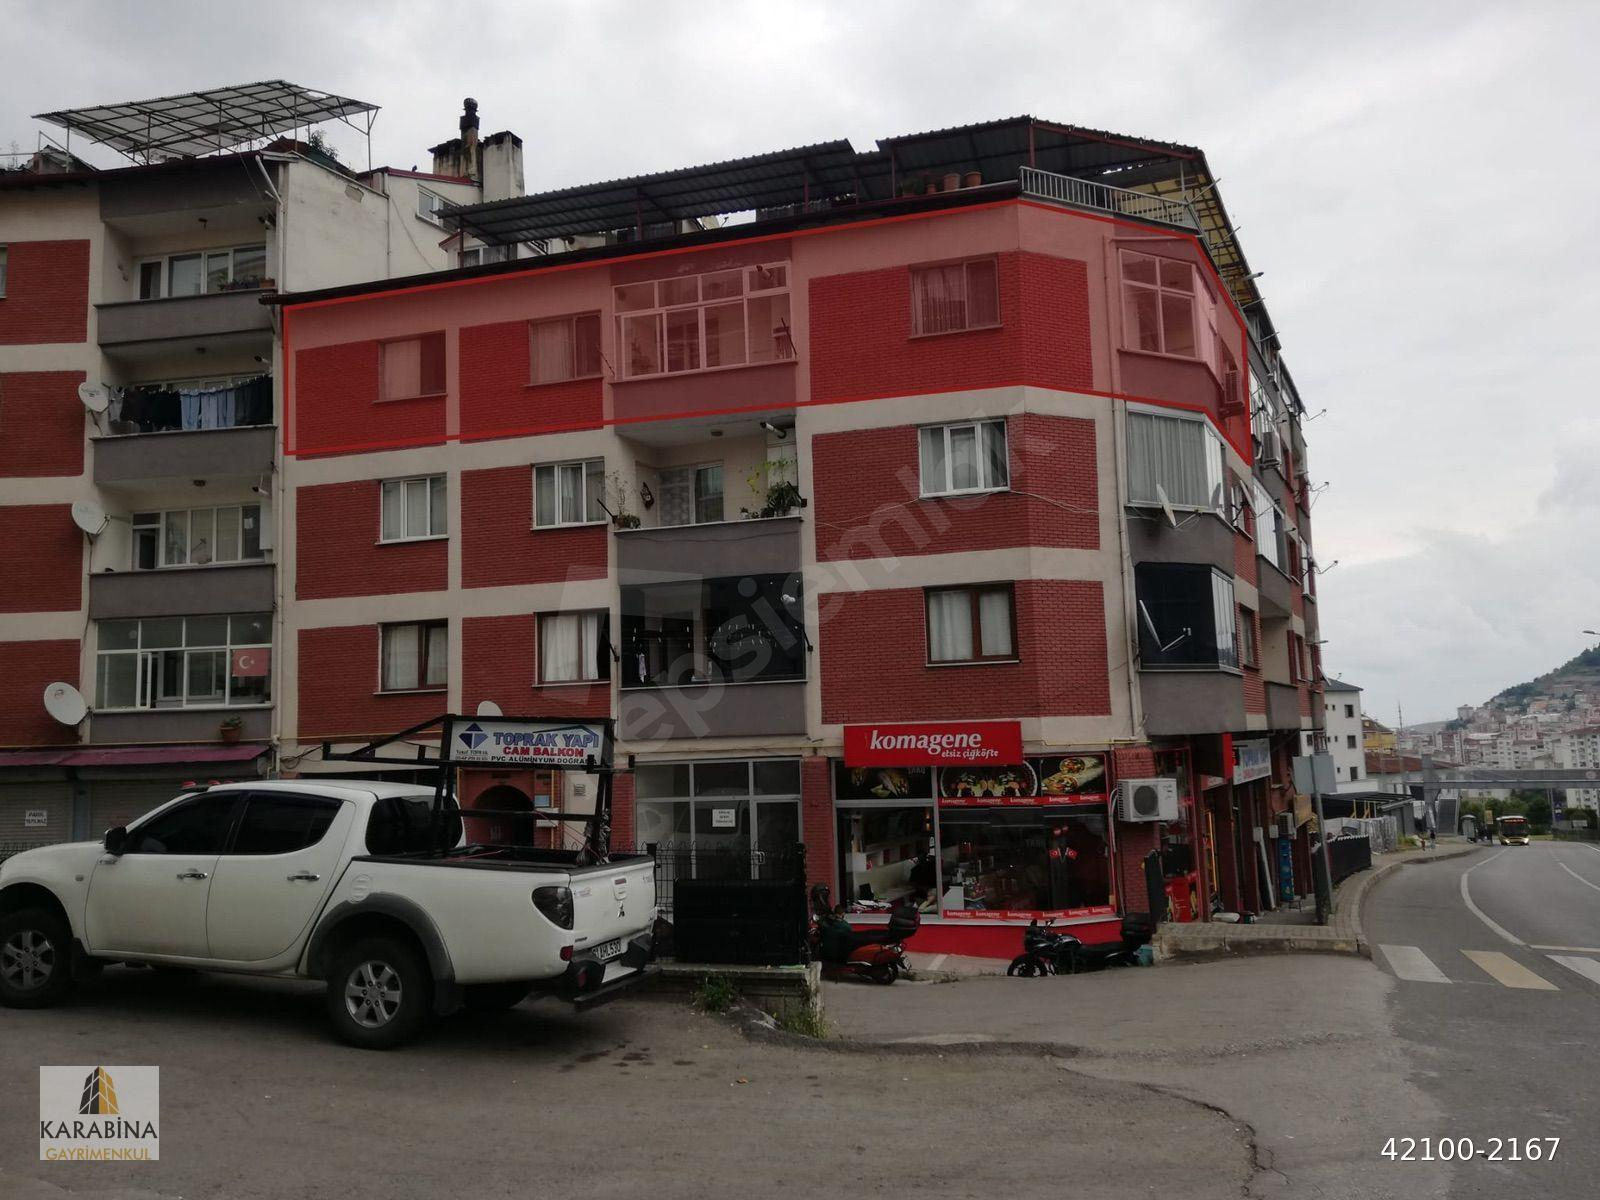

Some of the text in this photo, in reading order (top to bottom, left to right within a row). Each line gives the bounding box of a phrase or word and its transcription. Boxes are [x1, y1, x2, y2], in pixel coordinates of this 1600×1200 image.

[493, 732, 599, 748] TOPRAK YAPI
[869, 730, 982, 755] komagene
[503, 746, 584, 757] CAM BALKON
[941, 749, 961, 758] etsiz
[557, 757, 597, 765] DOĞRAA
